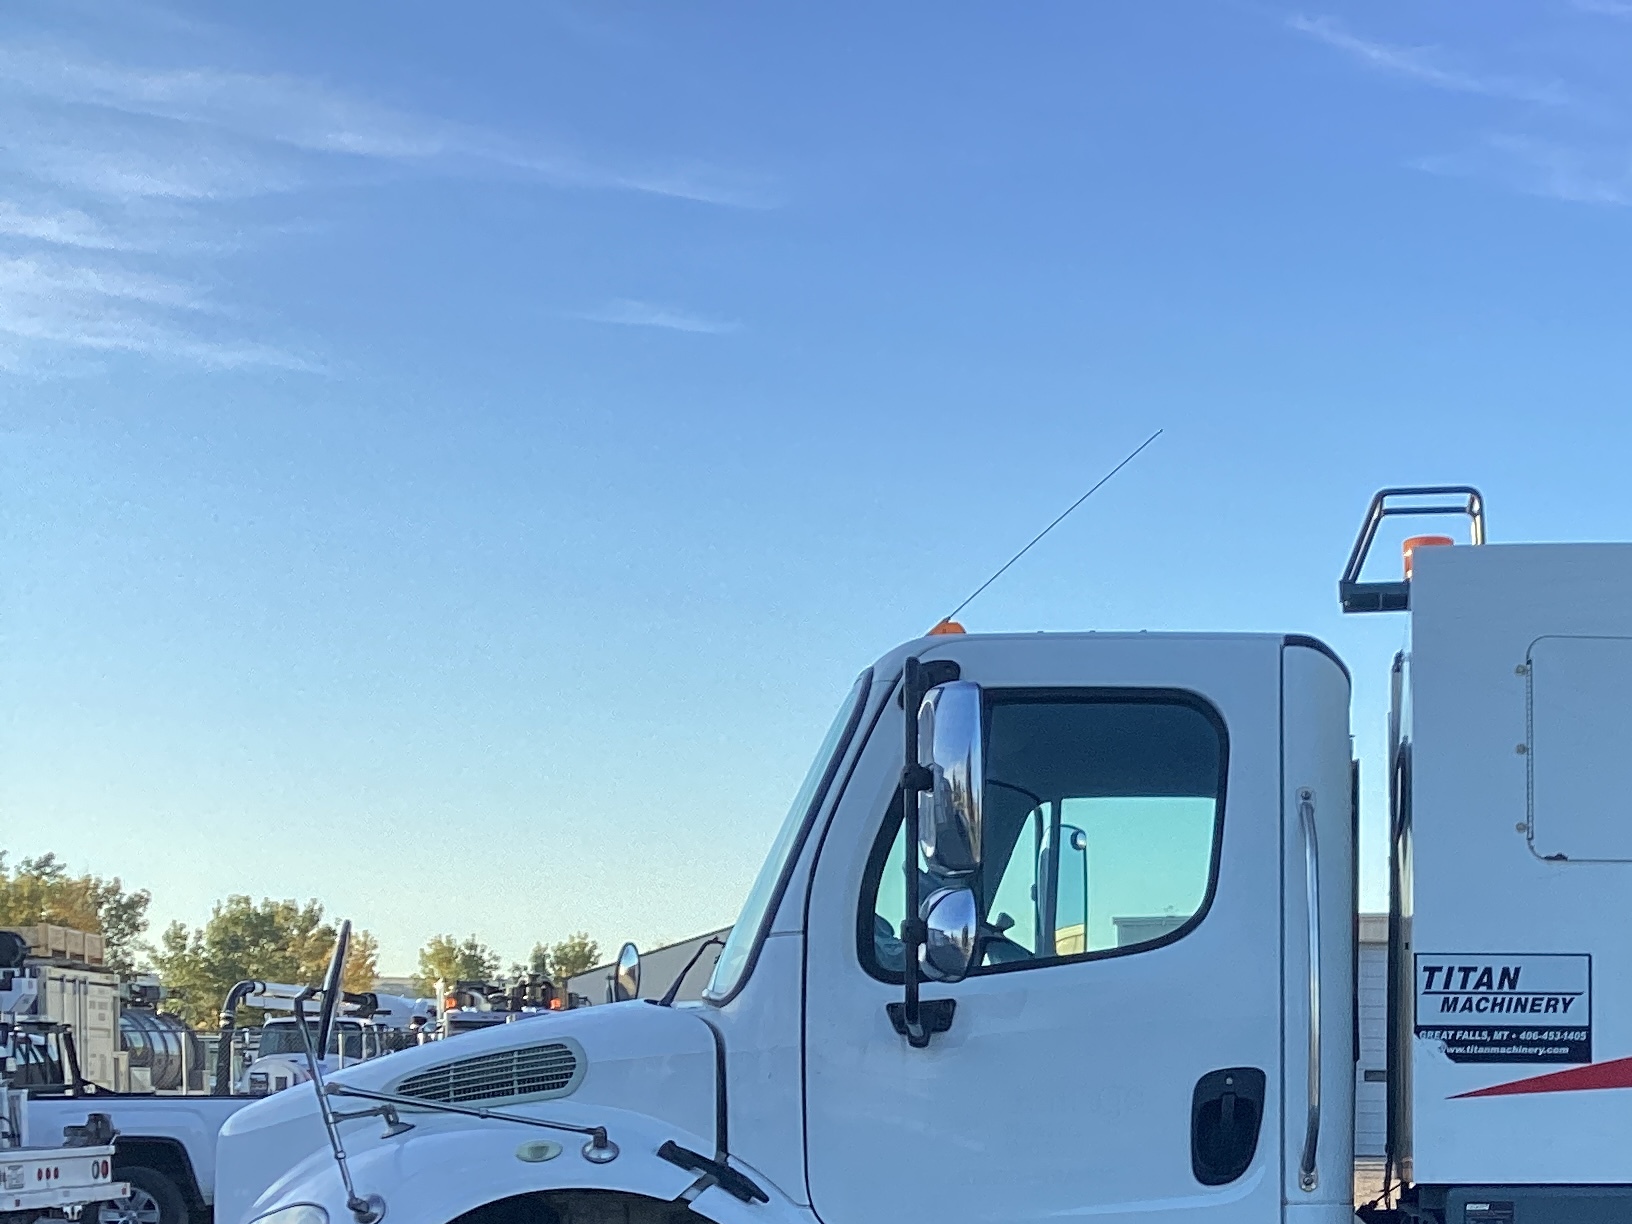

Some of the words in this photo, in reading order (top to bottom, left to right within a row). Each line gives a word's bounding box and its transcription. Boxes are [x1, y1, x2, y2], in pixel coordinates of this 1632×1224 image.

[1422, 966, 1521, 990] TITAN
[1440, 997, 1575, 1014] MACHINERY
[1419, 1031, 1454, 1040] GREAT
[1456, 1031, 1491, 1042] FALLS,
[1493, 1031, 1510, 1040] MT
